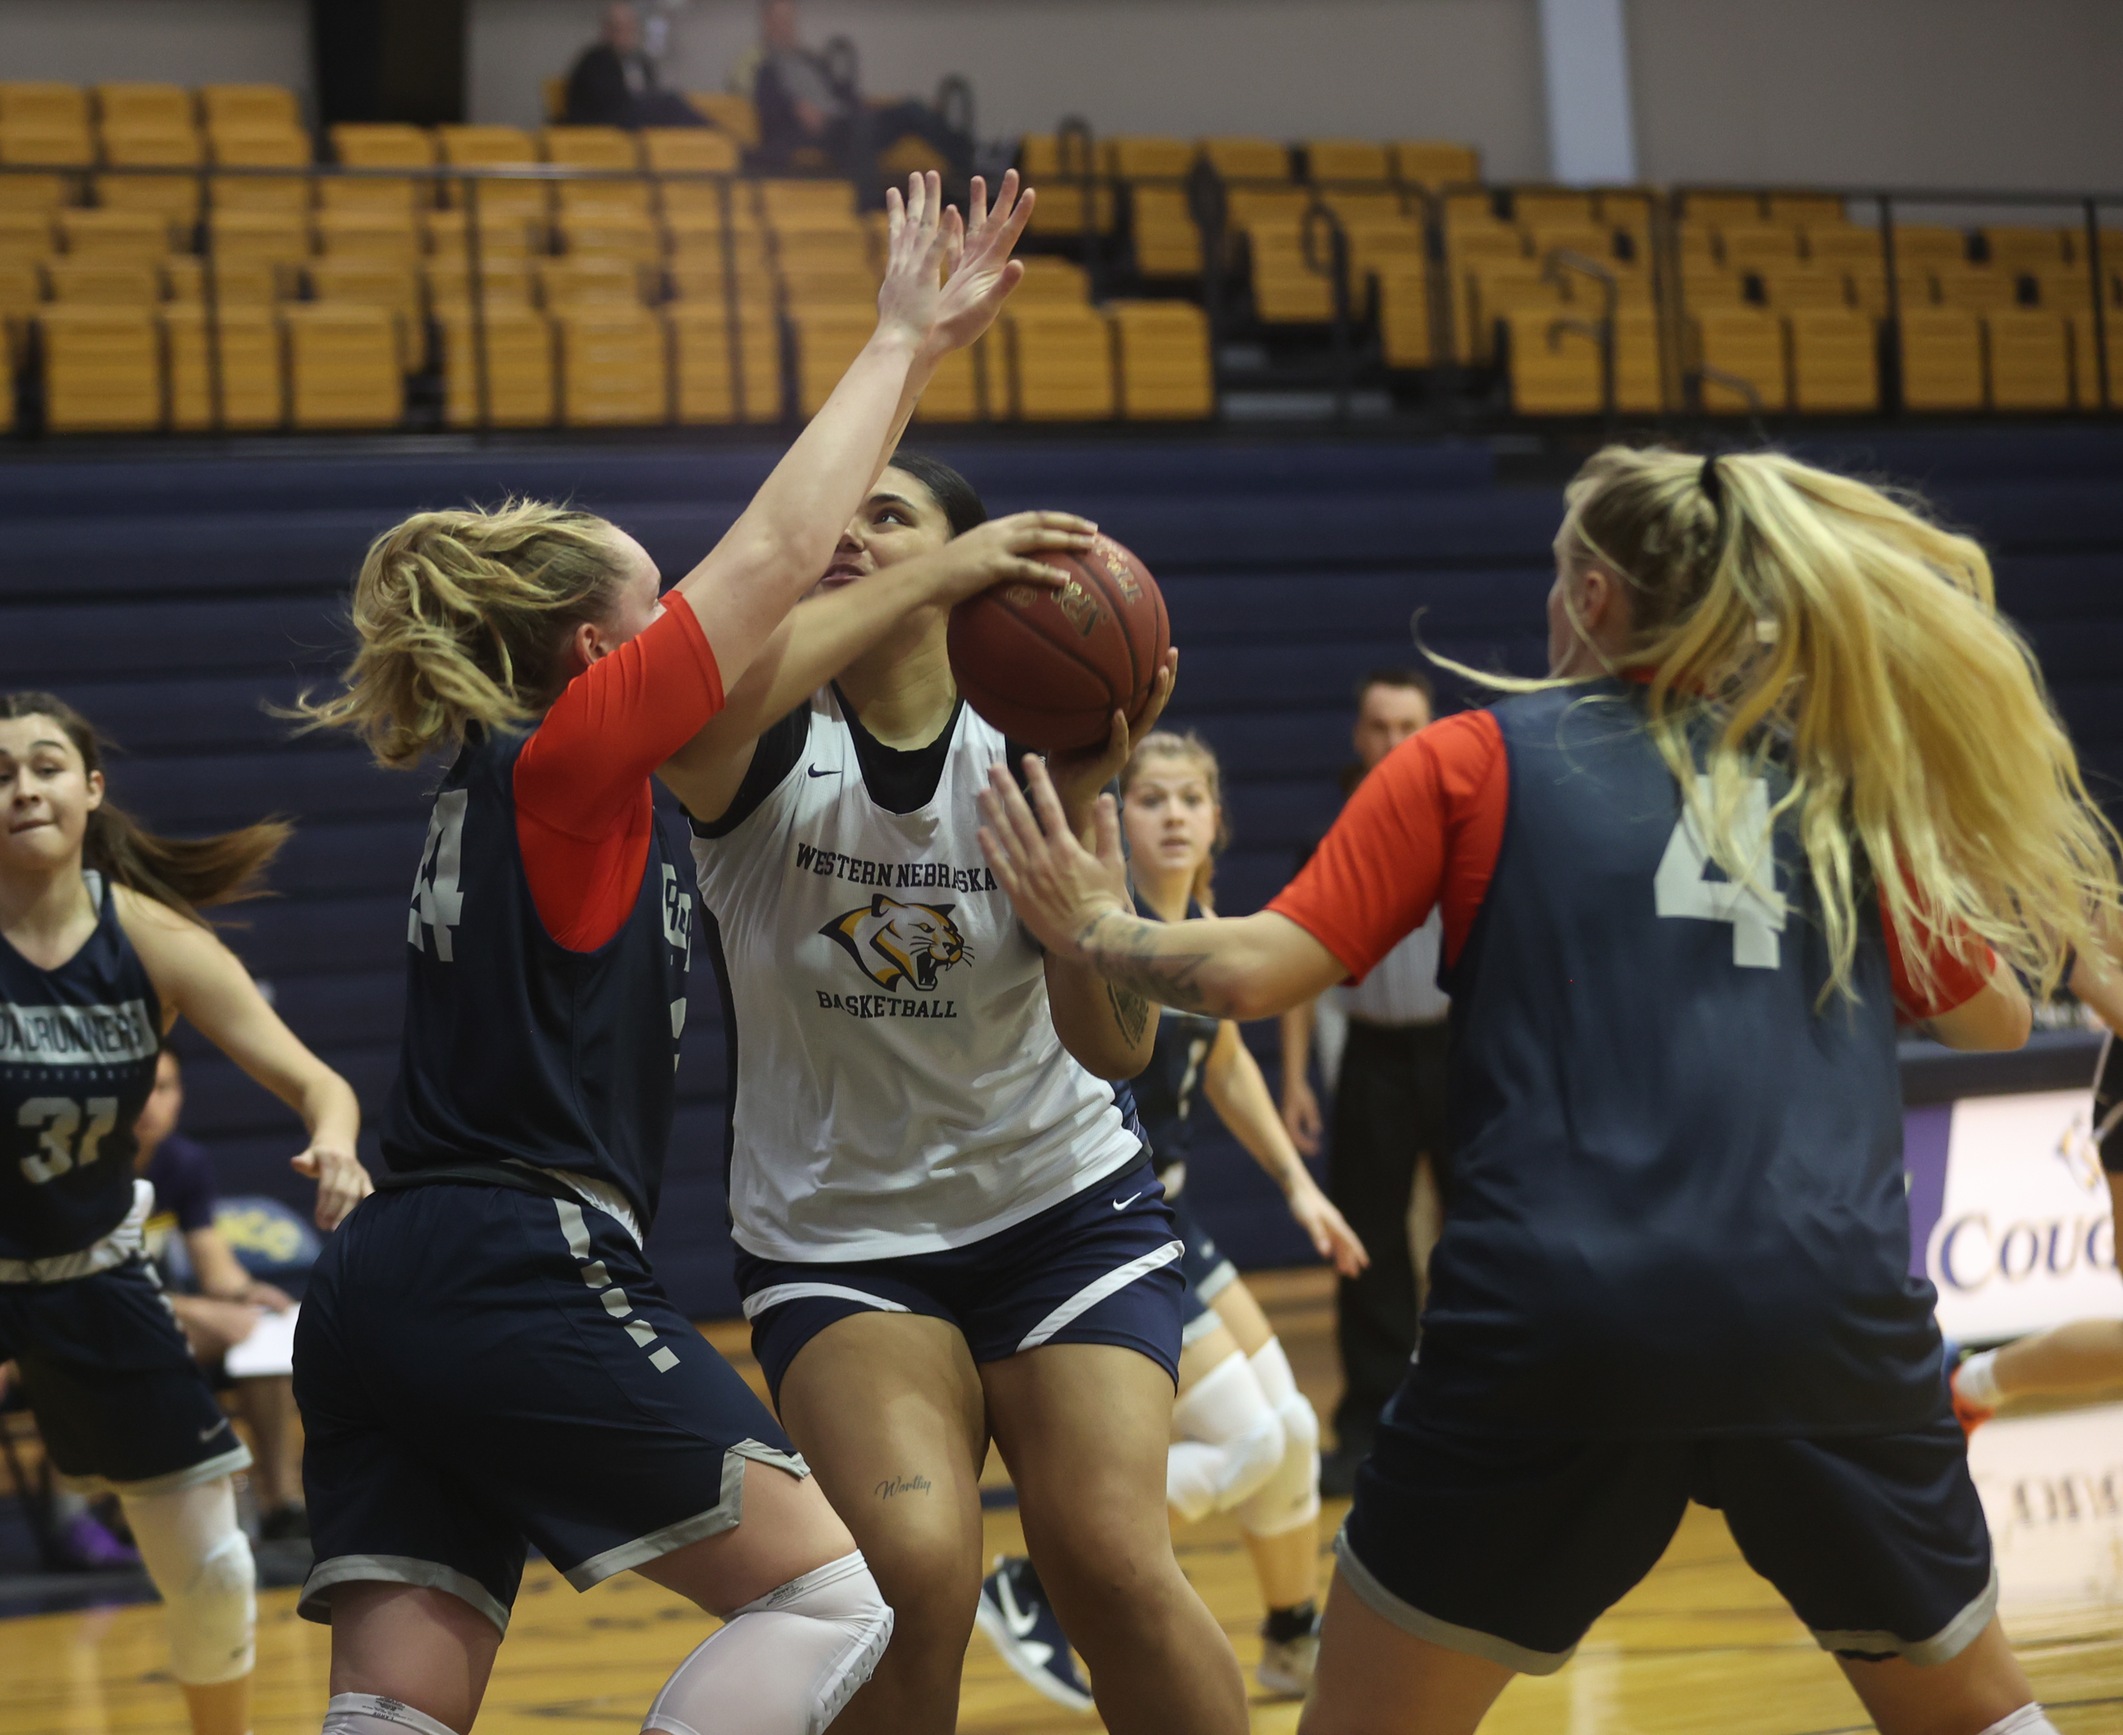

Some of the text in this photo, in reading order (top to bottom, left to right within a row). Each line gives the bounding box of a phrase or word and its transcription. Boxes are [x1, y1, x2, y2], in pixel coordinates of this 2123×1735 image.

[796, 842, 997, 893] WESTERN NEBRASKA
[1653, 774, 1788, 970] 4
[816, 990, 957, 1019] BASKETBALL
